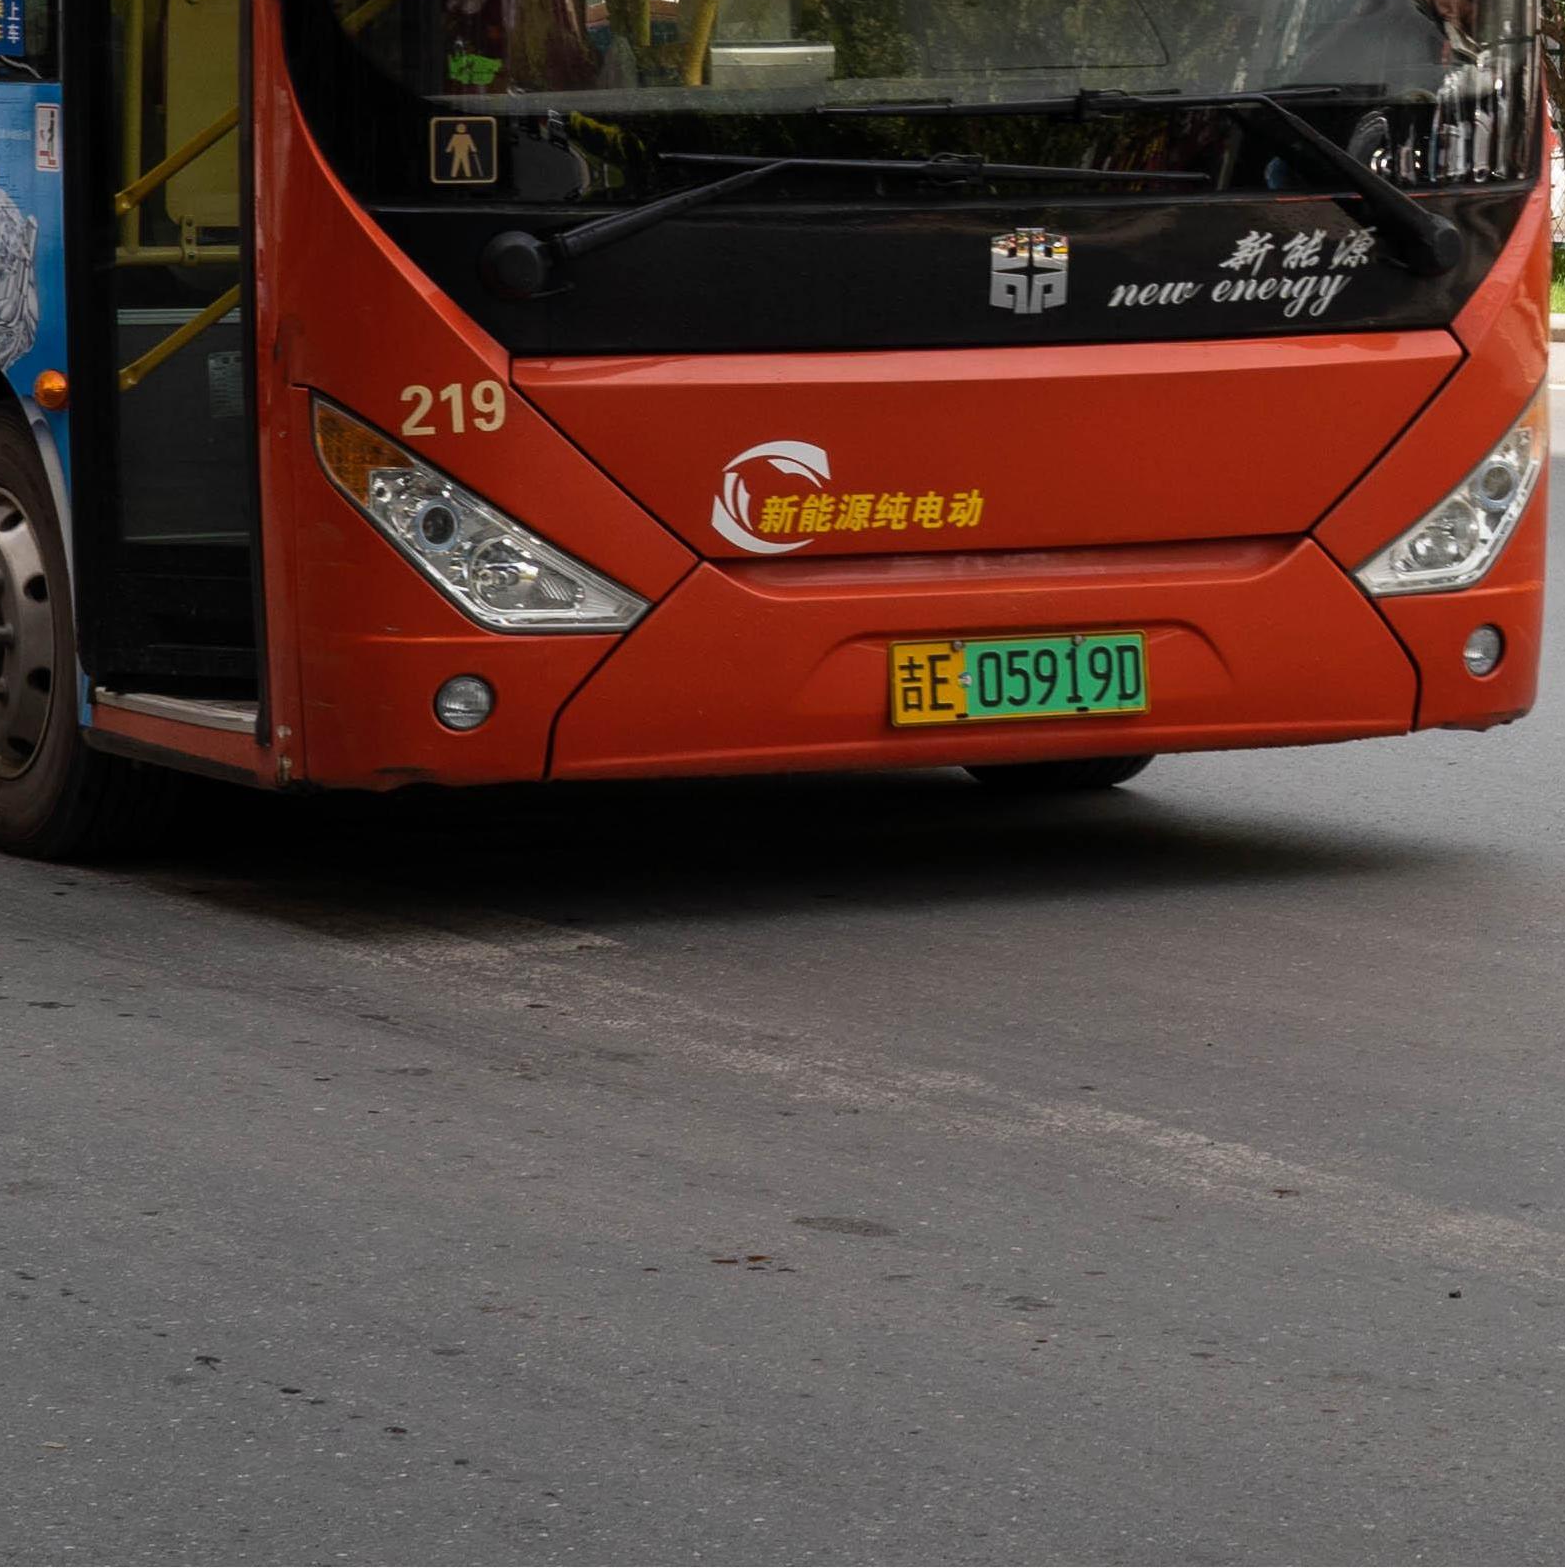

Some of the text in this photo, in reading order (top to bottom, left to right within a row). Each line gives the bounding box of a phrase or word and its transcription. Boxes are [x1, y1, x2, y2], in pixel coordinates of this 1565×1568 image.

[1218, 226, 1378, 276] 新能源
[1106, 273, 1352, 319] new energy
[399, 379, 507, 437] 219
[757, 488, 986, 534] 新能源纯电动
